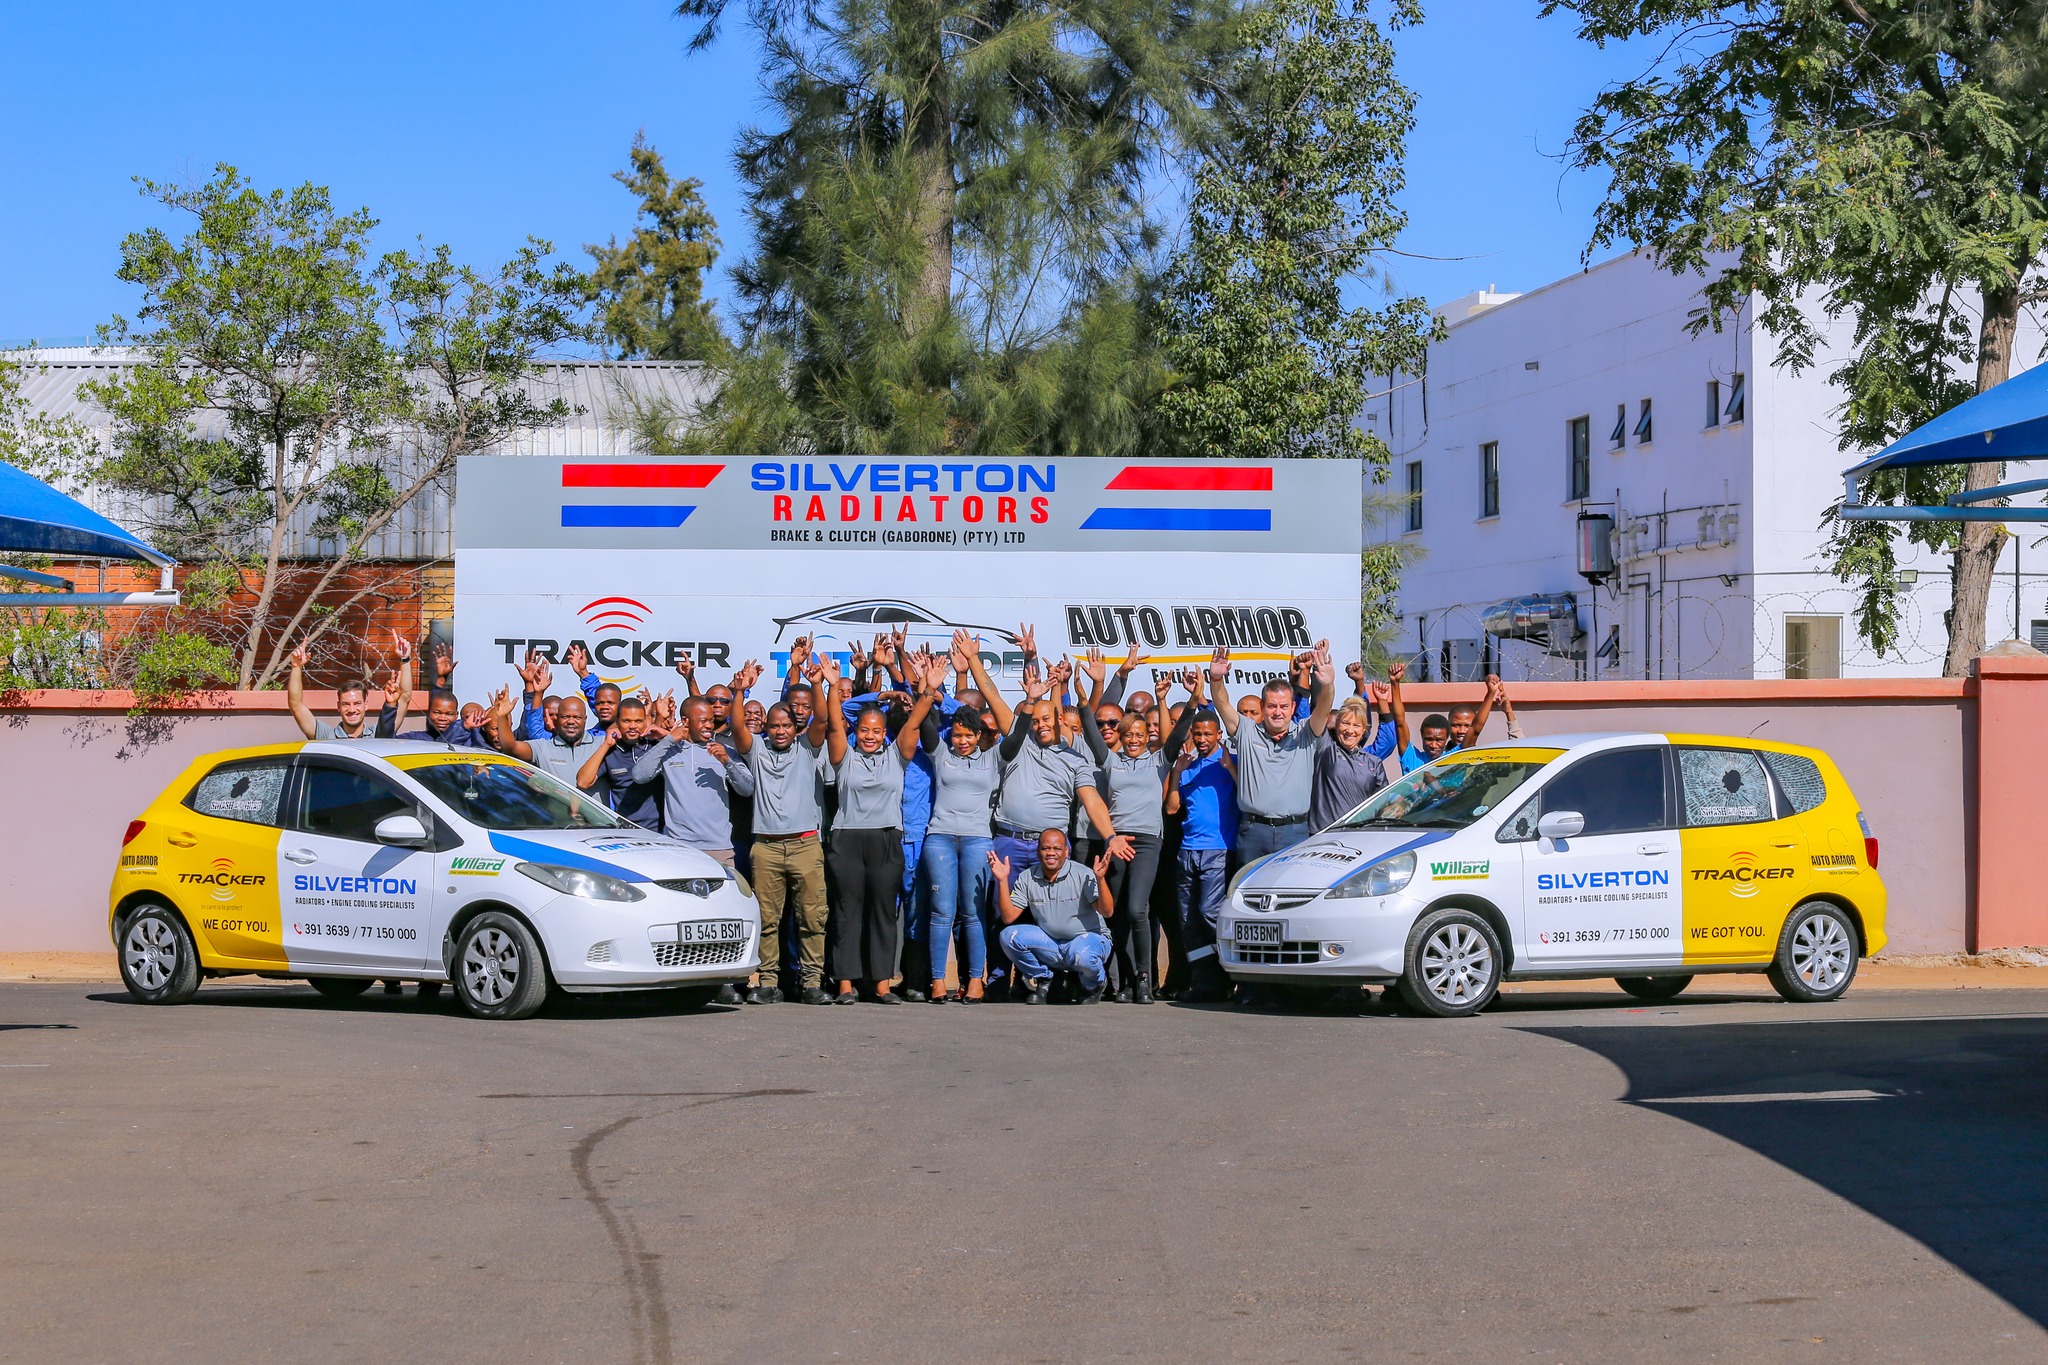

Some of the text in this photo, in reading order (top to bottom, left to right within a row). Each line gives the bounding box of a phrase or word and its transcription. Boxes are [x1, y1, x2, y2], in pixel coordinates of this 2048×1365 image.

[751, 463, 1056, 492] SILVERTON
[773, 495, 1049, 523] RADIATORS
[771, 529, 1025, 546] BRAKE & CLUTCH (GABORONE) (PTY) LTD
[1065, 605, 1313, 649] AUTO ARMOR
[494, 638, 731, 668] TRACKER
[122, 855, 158, 866] AUTO ARMOR
[451, 857, 506, 871] Willard
[1319, 852, 1357, 862] RIDE
[1811, 855, 1856, 866] AUTO ARMOR
[1430, 859, 1490, 875] Willard
[1691, 867, 1795, 882] TRACKER
[178, 873, 265, 886] TRACKER
[294, 875, 416, 894] SILVERTON
[1538, 870, 1669, 890] SILVERTON
[295, 897, 415, 909] RADIATORS ENGINE COOLING SPECIALISTS
[1539, 892, 1668, 904] RADIATORS ENGINE COOLING SPECIALISTS
[203, 919, 270, 932] WE GOT YOU.
[305, 923, 416, 940] 391 3639 / 77 150 000
[684, 923, 741, 940] B 545 BSM
[1691, 926, 1765, 939] WE GOT YOU.
[1552, 927, 1669, 943] 391 3639 / 77 150 000
